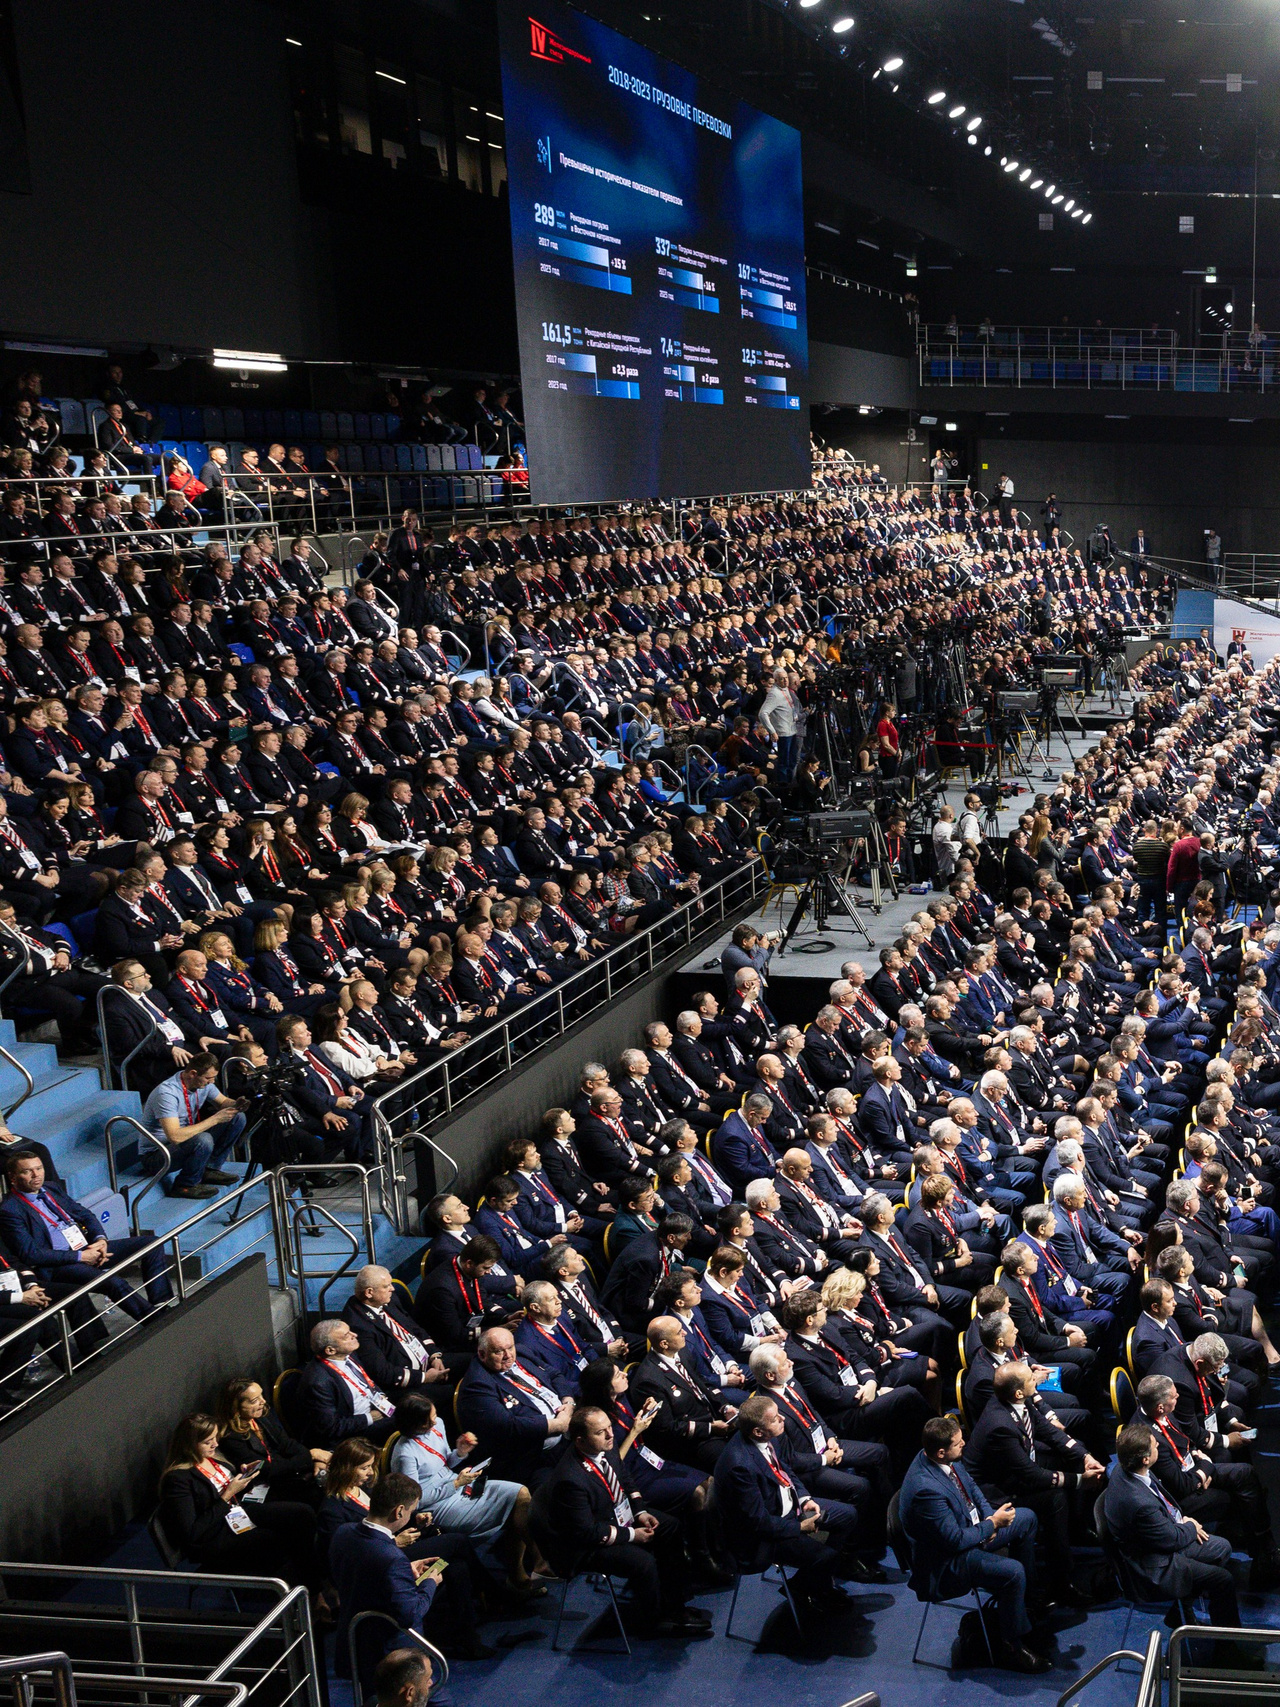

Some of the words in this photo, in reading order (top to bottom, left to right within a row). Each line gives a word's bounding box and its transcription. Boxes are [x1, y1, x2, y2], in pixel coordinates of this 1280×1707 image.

[608, 64, 651, 100] 2018-2023
[652, 87, 692, 121] ГРУЗОВЫЕ
[692, 107, 732, 140] ПЕРЕВОЗКИ
[534, 202, 555, 227] 289
[655, 236, 670, 256] 337
[738, 263, 750, 280] 167
[542, 322, 571, 347] 161,5
[661, 337, 673, 358] 7,4
[742, 348, 756, 367] 12,5
